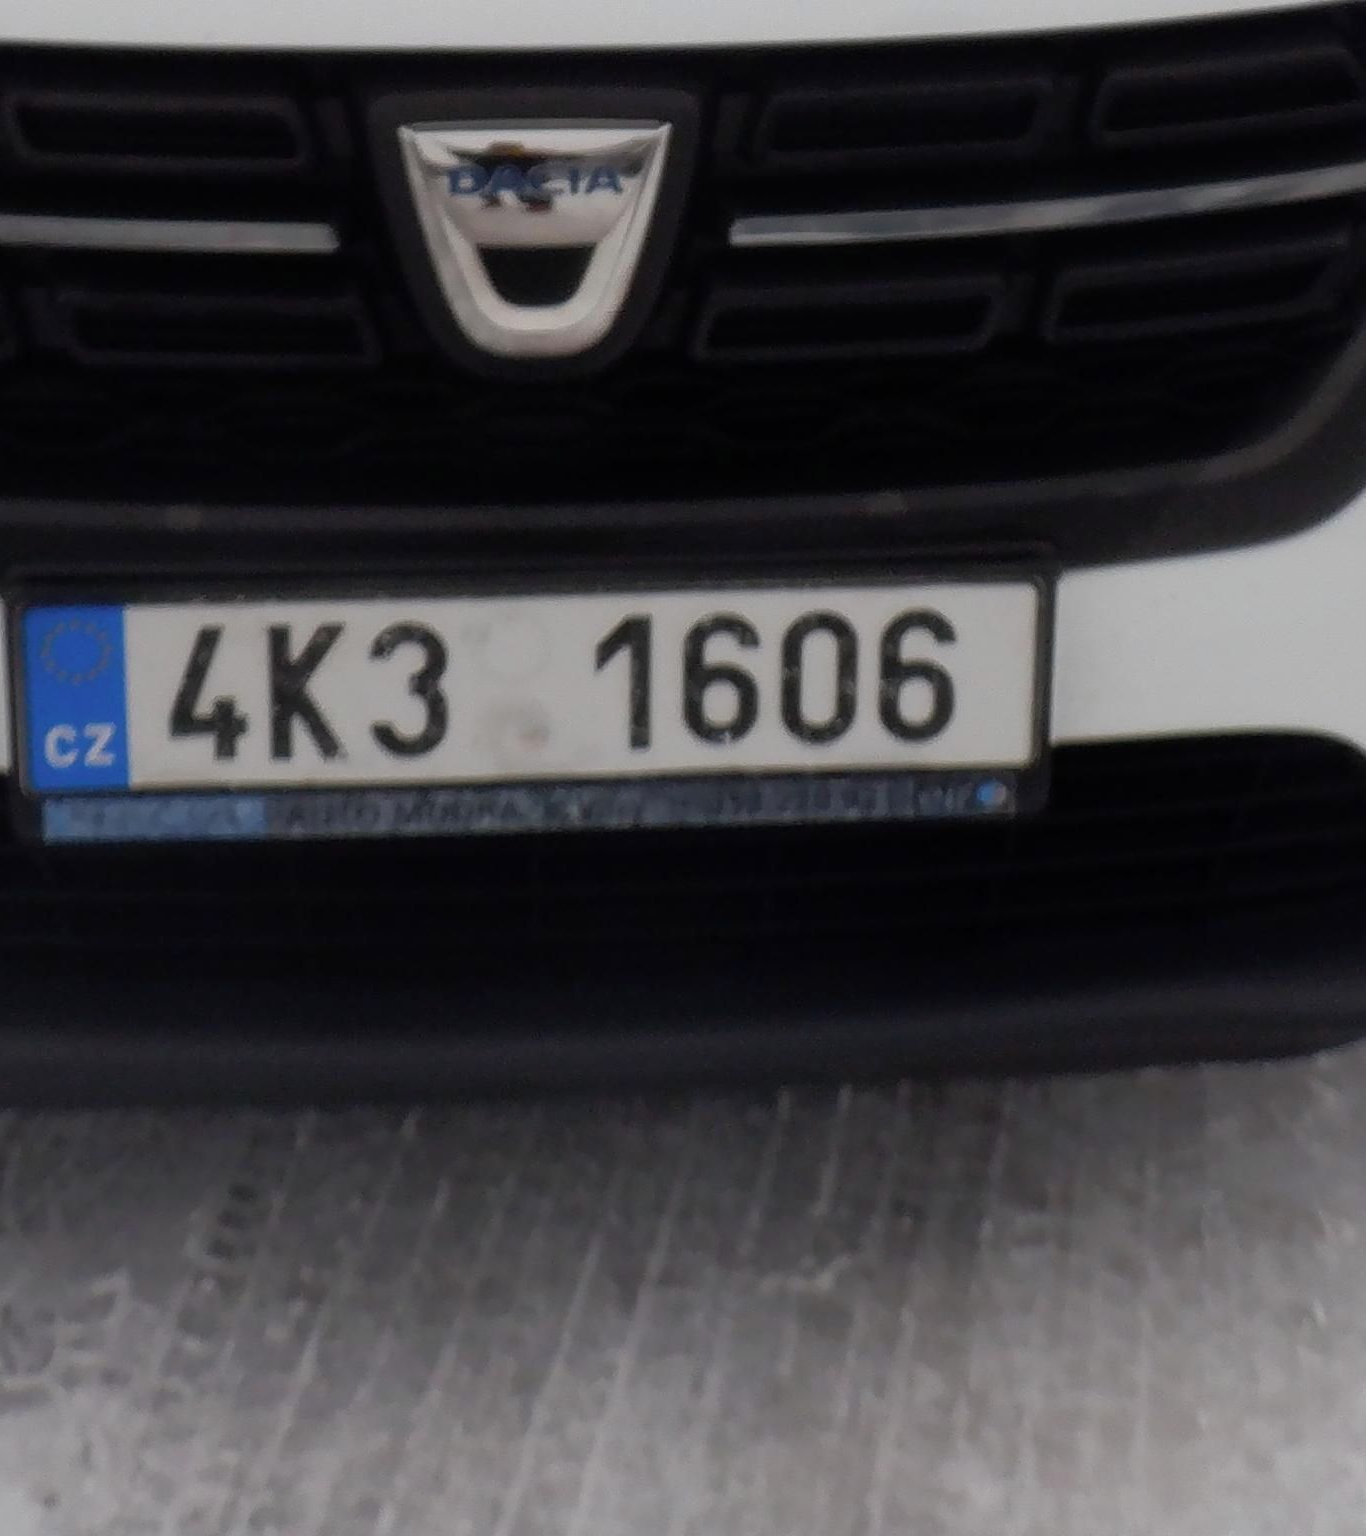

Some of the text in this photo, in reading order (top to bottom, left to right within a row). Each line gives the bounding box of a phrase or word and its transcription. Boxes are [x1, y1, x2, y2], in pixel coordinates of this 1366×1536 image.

[446, 165, 622, 198] DACIA
[169, 607, 957, 762] 4K3 1606
[43, 722, 116, 768] CZ
